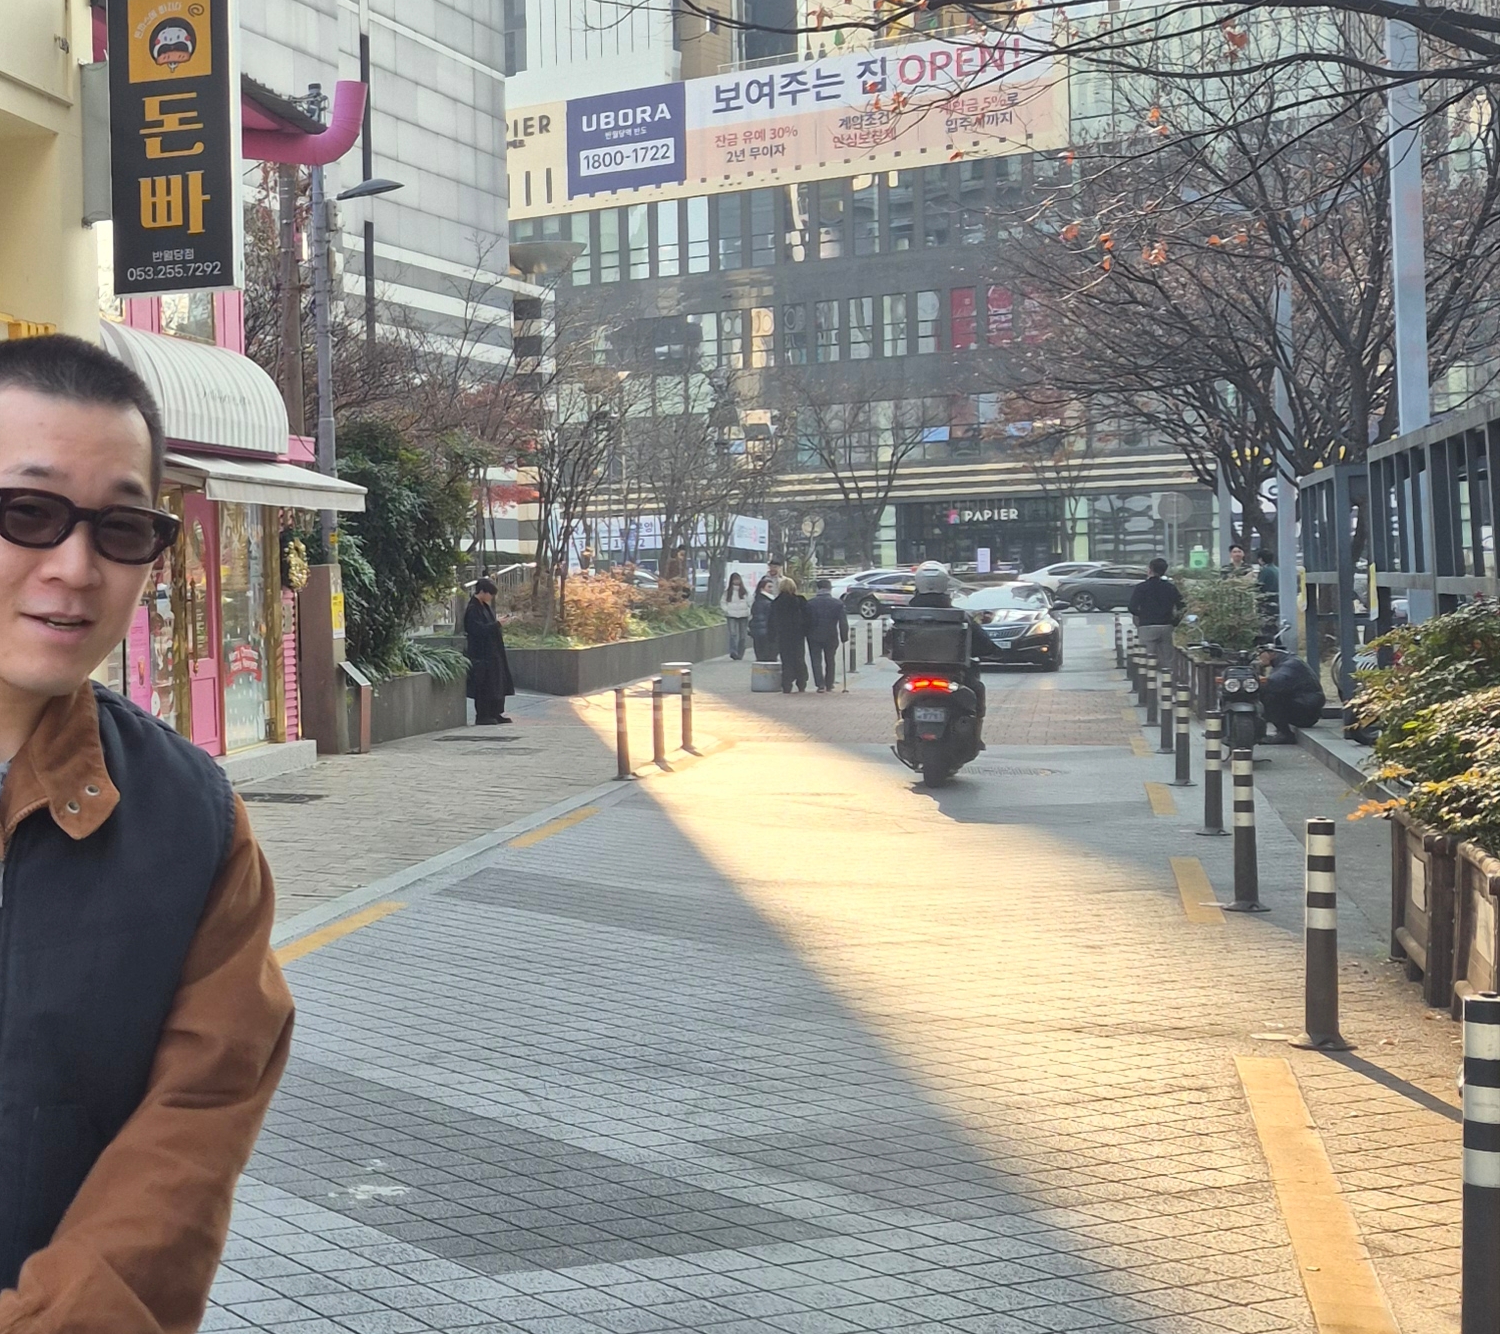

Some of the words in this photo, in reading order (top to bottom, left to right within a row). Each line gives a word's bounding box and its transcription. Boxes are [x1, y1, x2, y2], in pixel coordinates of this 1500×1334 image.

[712, 68, 845, 114] 보여주는
[856, 56, 888, 95] 집
[898, 38, 1022, 85] OPEN!
[506, 114, 551, 138] IER
[581, 103, 672, 133] UBORA
[838, 110, 890, 130] 계약조건
[715, 133, 738, 148] 잔금
[742, 129, 766, 145] 유예
[769, 125, 799, 140] 30%
[138, 92, 211, 234] 돈빠
[583, 143, 671, 170] 1800-1722
[726, 148, 746, 163] 2년
[749, 143, 786, 160] 무이자
[152, 248, 195, 263] 반월당점
[127, 261, 222, 281] 053.255.7292
[963, 509, 1019, 522] PAPIER
